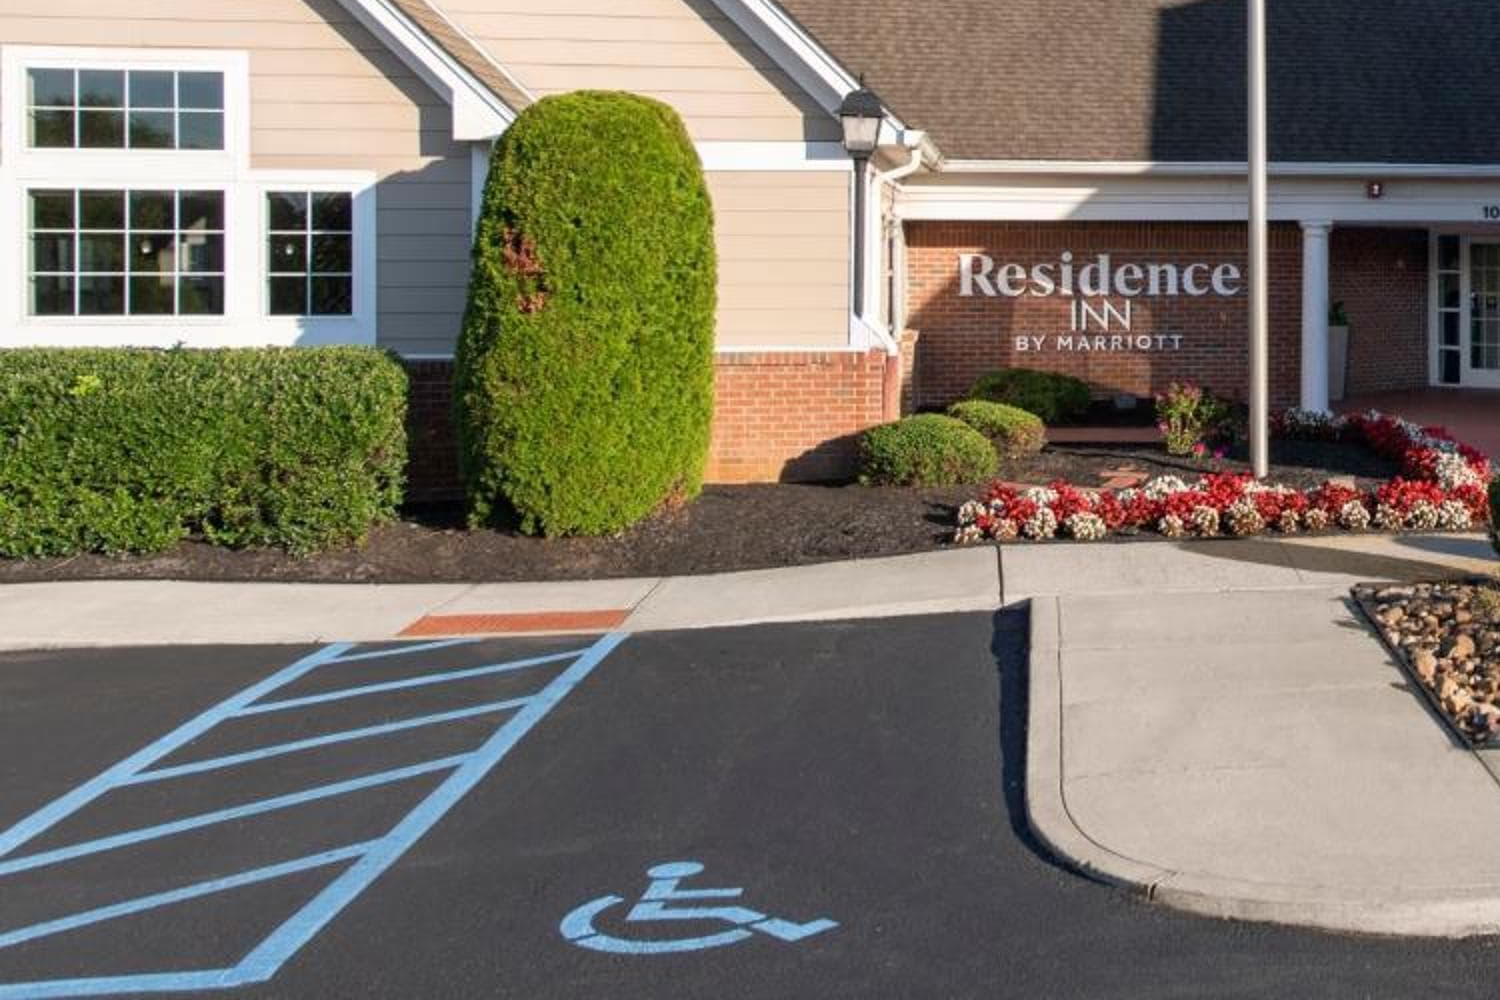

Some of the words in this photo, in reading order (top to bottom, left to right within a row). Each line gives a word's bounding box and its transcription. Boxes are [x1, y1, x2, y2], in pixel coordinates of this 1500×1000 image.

[958, 251, 1241, 296] Residence
[1071, 299, 1131, 331] INN
[1015, 335, 1045, 351] BY
[1057, 334, 1183, 351] MARRIOTT
